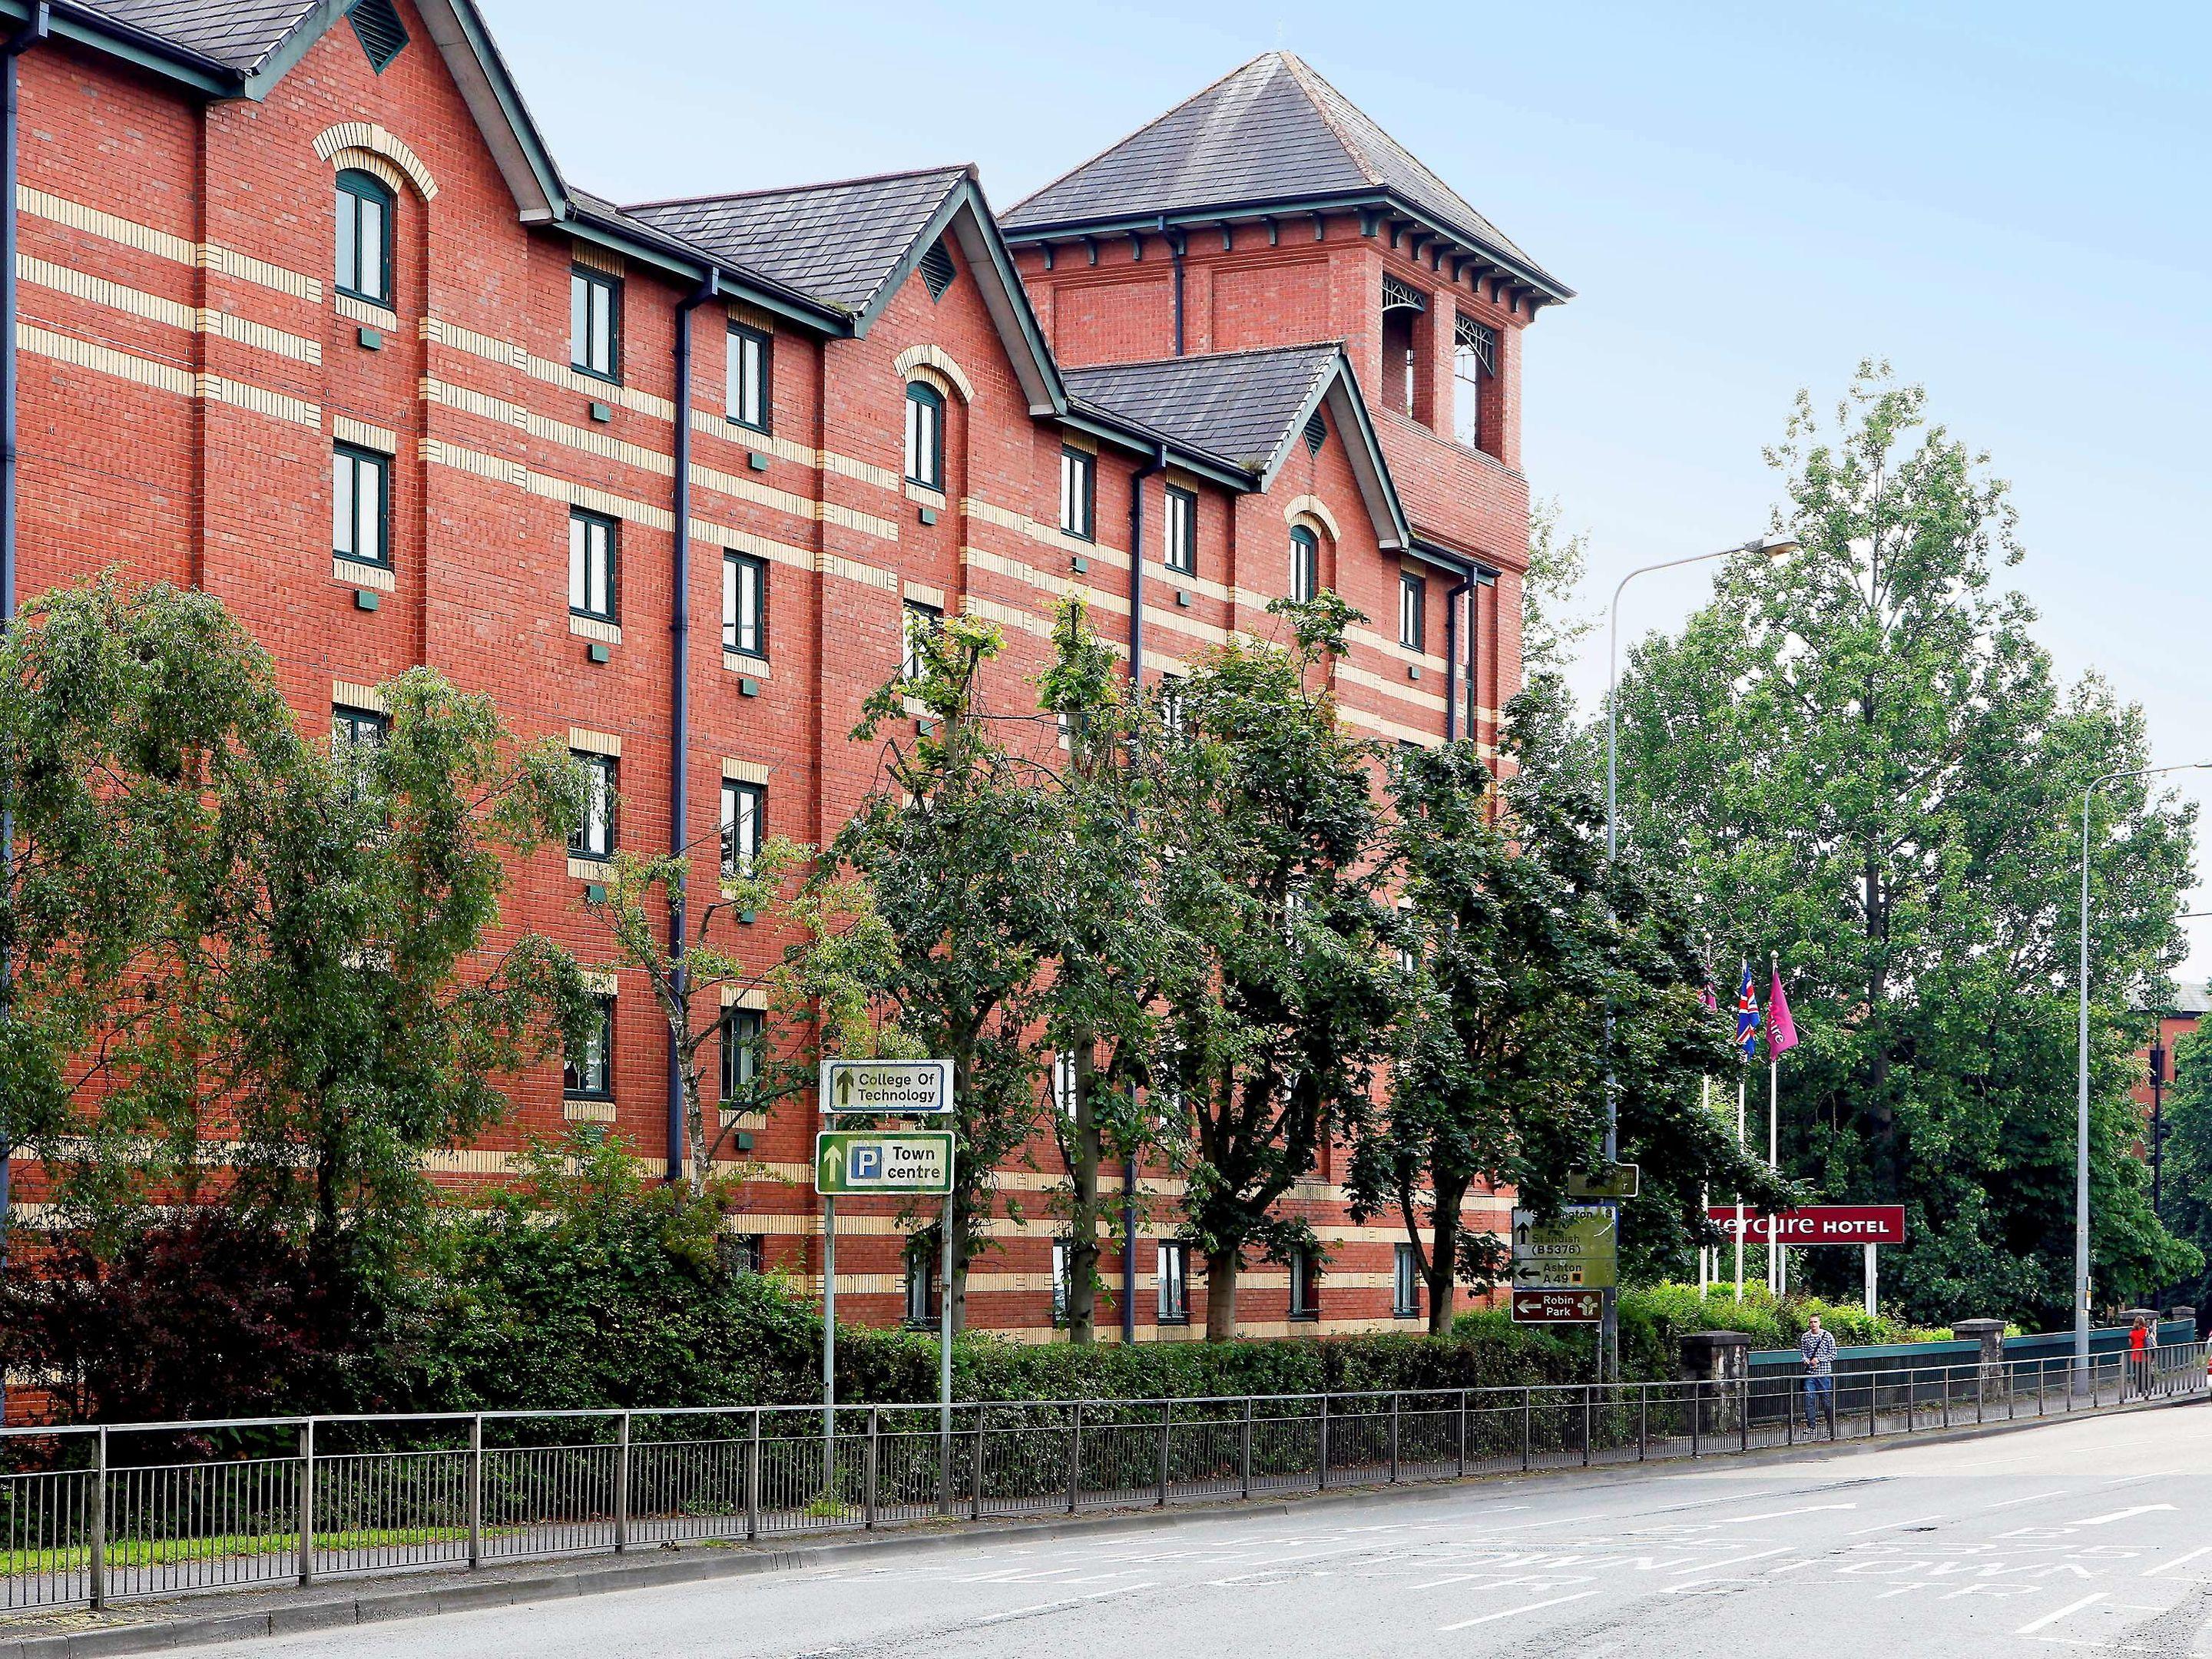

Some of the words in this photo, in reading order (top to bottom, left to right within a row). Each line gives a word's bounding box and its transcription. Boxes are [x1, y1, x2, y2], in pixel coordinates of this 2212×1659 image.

[859, 1073, 912, 1088] College
[918, 1073, 935, 1085] Of
[858, 1088, 935, 1103] Technology
[892, 1146, 935, 1161] Town
[858, 1150, 878, 1177] P
[887, 1165, 940, 1179] centre
[1823, 1220, 1889, 1233] HOTEL
[1532, 1234, 1580, 1243] Standish
[1543, 1263, 1582, 1272] Ashton
[1543, 1295, 1575, 1305] Robin
[1546, 1307, 1571, 1316] Park
